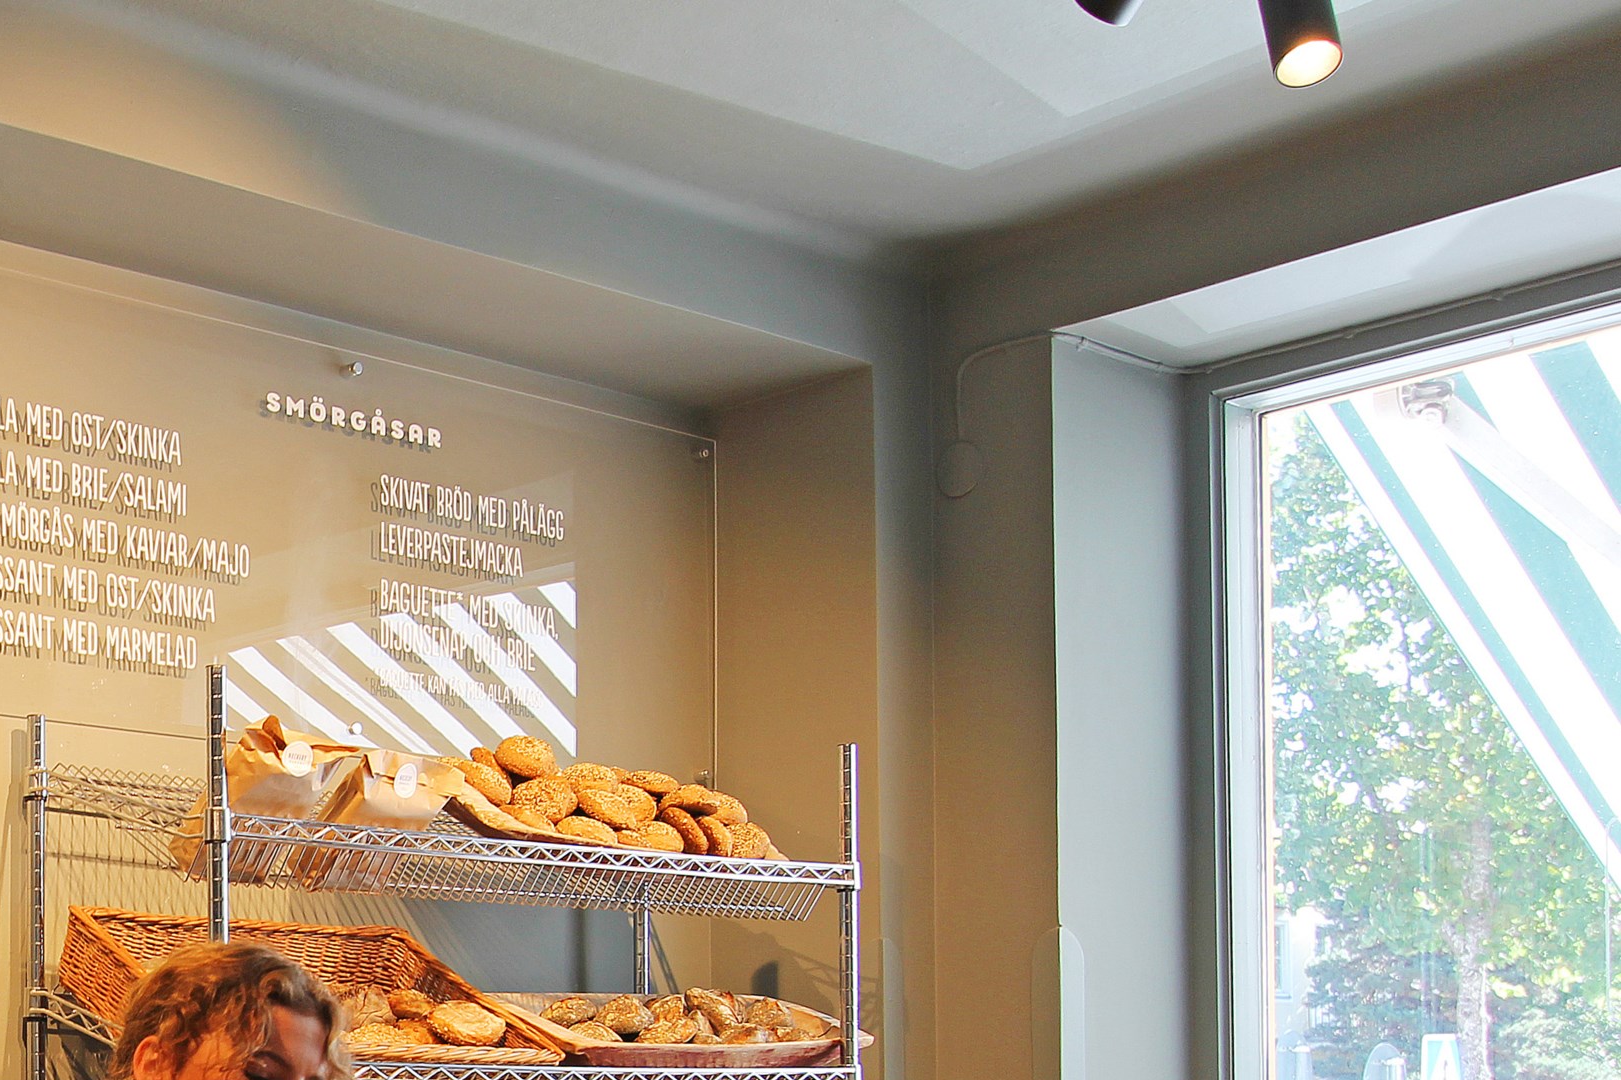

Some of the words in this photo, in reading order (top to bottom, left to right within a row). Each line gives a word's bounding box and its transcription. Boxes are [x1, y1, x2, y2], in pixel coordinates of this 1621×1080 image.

[26, 402, 63, 441] MED
[71, 411, 182, 466] OST/SKINKA
[266, 392, 442, 448] SMÖRGÅSAR
[26, 454, 63, 493] MED
[71, 462, 187, 516] BRIE/SALAMI
[380, 474, 430, 514] SKIVAT
[436, 485, 472, 522] BRÖD
[478, 495, 507, 529] MED
[512, 498, 564, 541] PÅLÄGG
[82, 517, 118, 556] MED
[126, 525, 250, 579] KAVIAR/MAJO
[380, 521, 524, 578] LEVERPASTEJMACKA
[63, 564, 98, 605] MED
[106, 573, 216, 624] OST/SKINKA
[469, 594, 498, 629] MED
[504, 601, 558, 640] SKINKA,
[63, 617, 98, 656] MED
[105, 624, 197, 670] MARMELAD
[380, 619, 467, 660] DIJONSENAP
[507, 638, 536, 672] BRIE
[427, 674, 447, 694] KAN
[488, 684, 510, 704] ALLA
